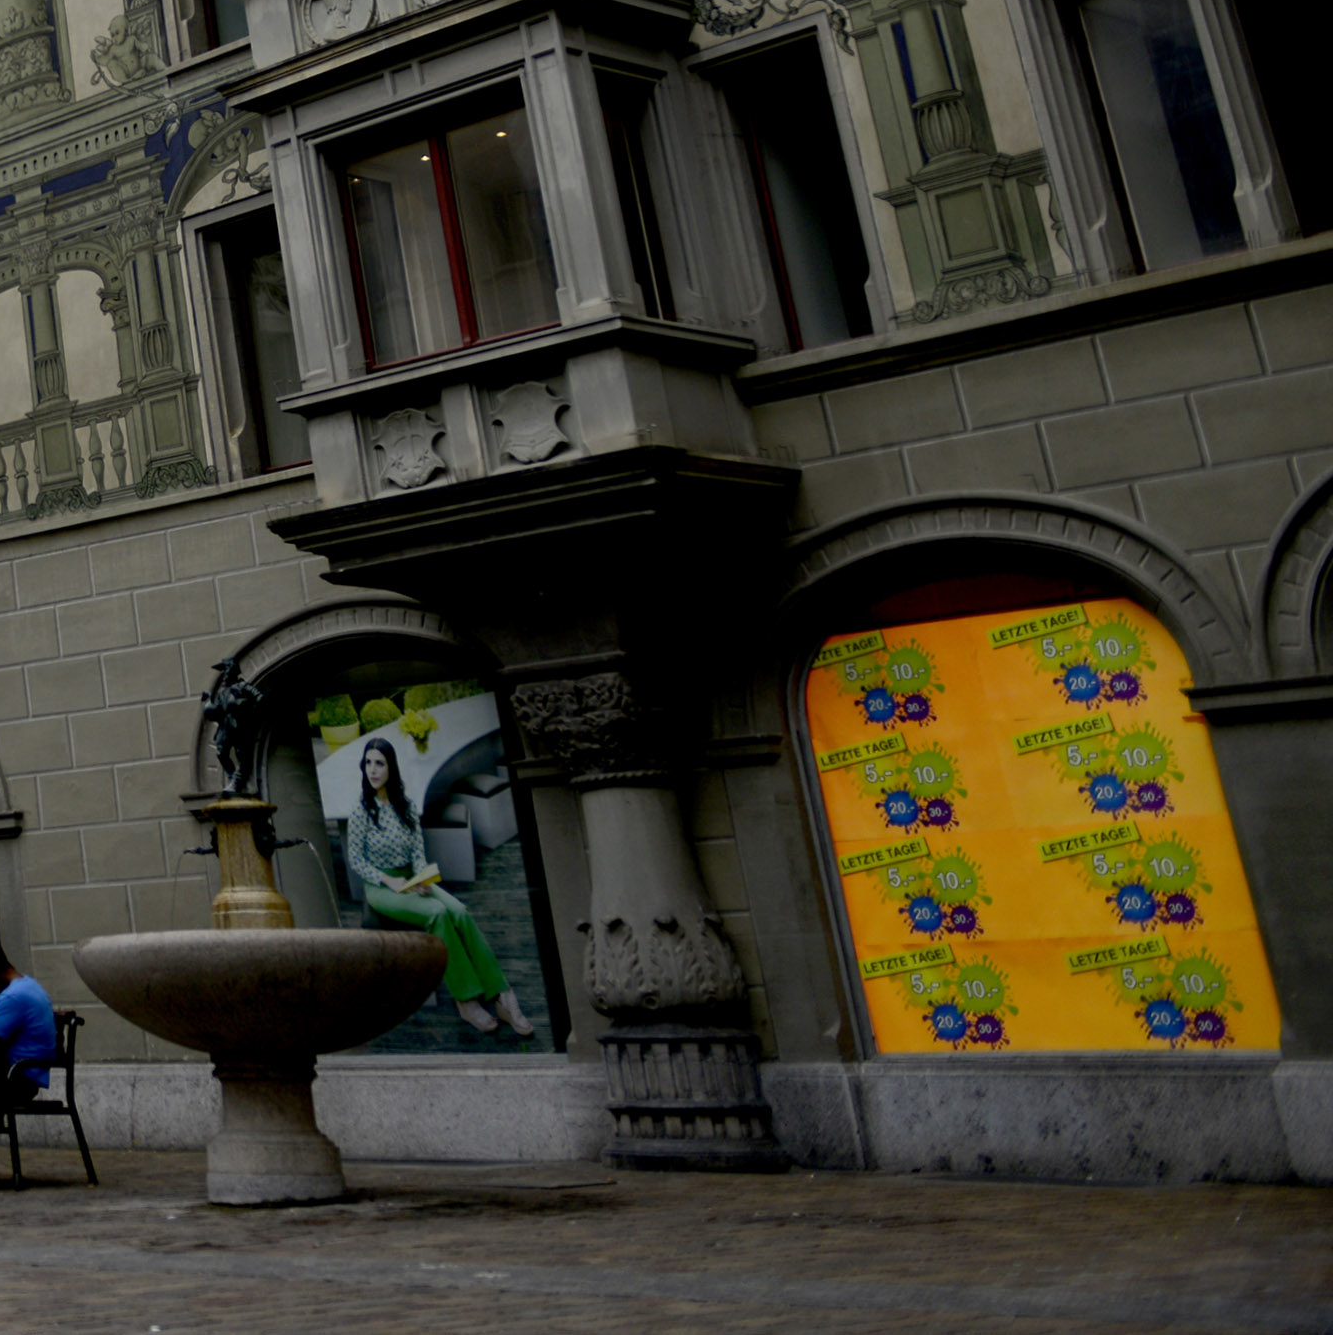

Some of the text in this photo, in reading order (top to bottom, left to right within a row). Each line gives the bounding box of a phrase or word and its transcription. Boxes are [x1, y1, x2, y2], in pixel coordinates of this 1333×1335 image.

[992, 610, 1080, 643] LETZTE TAGE!
[845, 636, 878, 654] TAGE!
[1042, 638, 1134, 658] 5.- 10.-
[845, 662, 925, 681] 5.- 10.-
[1069, 677, 1135, 692] 20.- 30.-
[868, 698, 925, 713] 20.- 30.-
[1016, 717, 1105, 749] LETZTE TAGE!
[820, 737, 900, 766] LETZTE TAGE!
[1067, 745, 1162, 767] 5.- 10.-
[865, 763, 949, 784] 5.- 10.-
[1094, 786, 1162, 803] 20.- 30.-
[889, 801, 948, 817] 20.- 30.-
[1042, 826, 1131, 856] LETZTE TAGE!
[840, 841, 922, 870] LETZTE TAGE!
[1093, 854, 1189, 877] 5.- 10.-
[887, 868, 972, 889] 5.- 10.-
[913, 907, 973, 924] 20.- 30.-
[1122, 896, 1190, 914] 20.- 30.-
[863, 948, 946, 974] LETZTE TAGE!
[1069, 940, 1160, 968] LETZTE TAGE!
[911, 973, 998, 998] 5.- 10.-
[1122, 968, 1219, 994] 5.- 10.-
[936, 1016, 998, 1034] 20.- 30.-
[1150, 1012, 1220, 1032] 20.- 30.-
